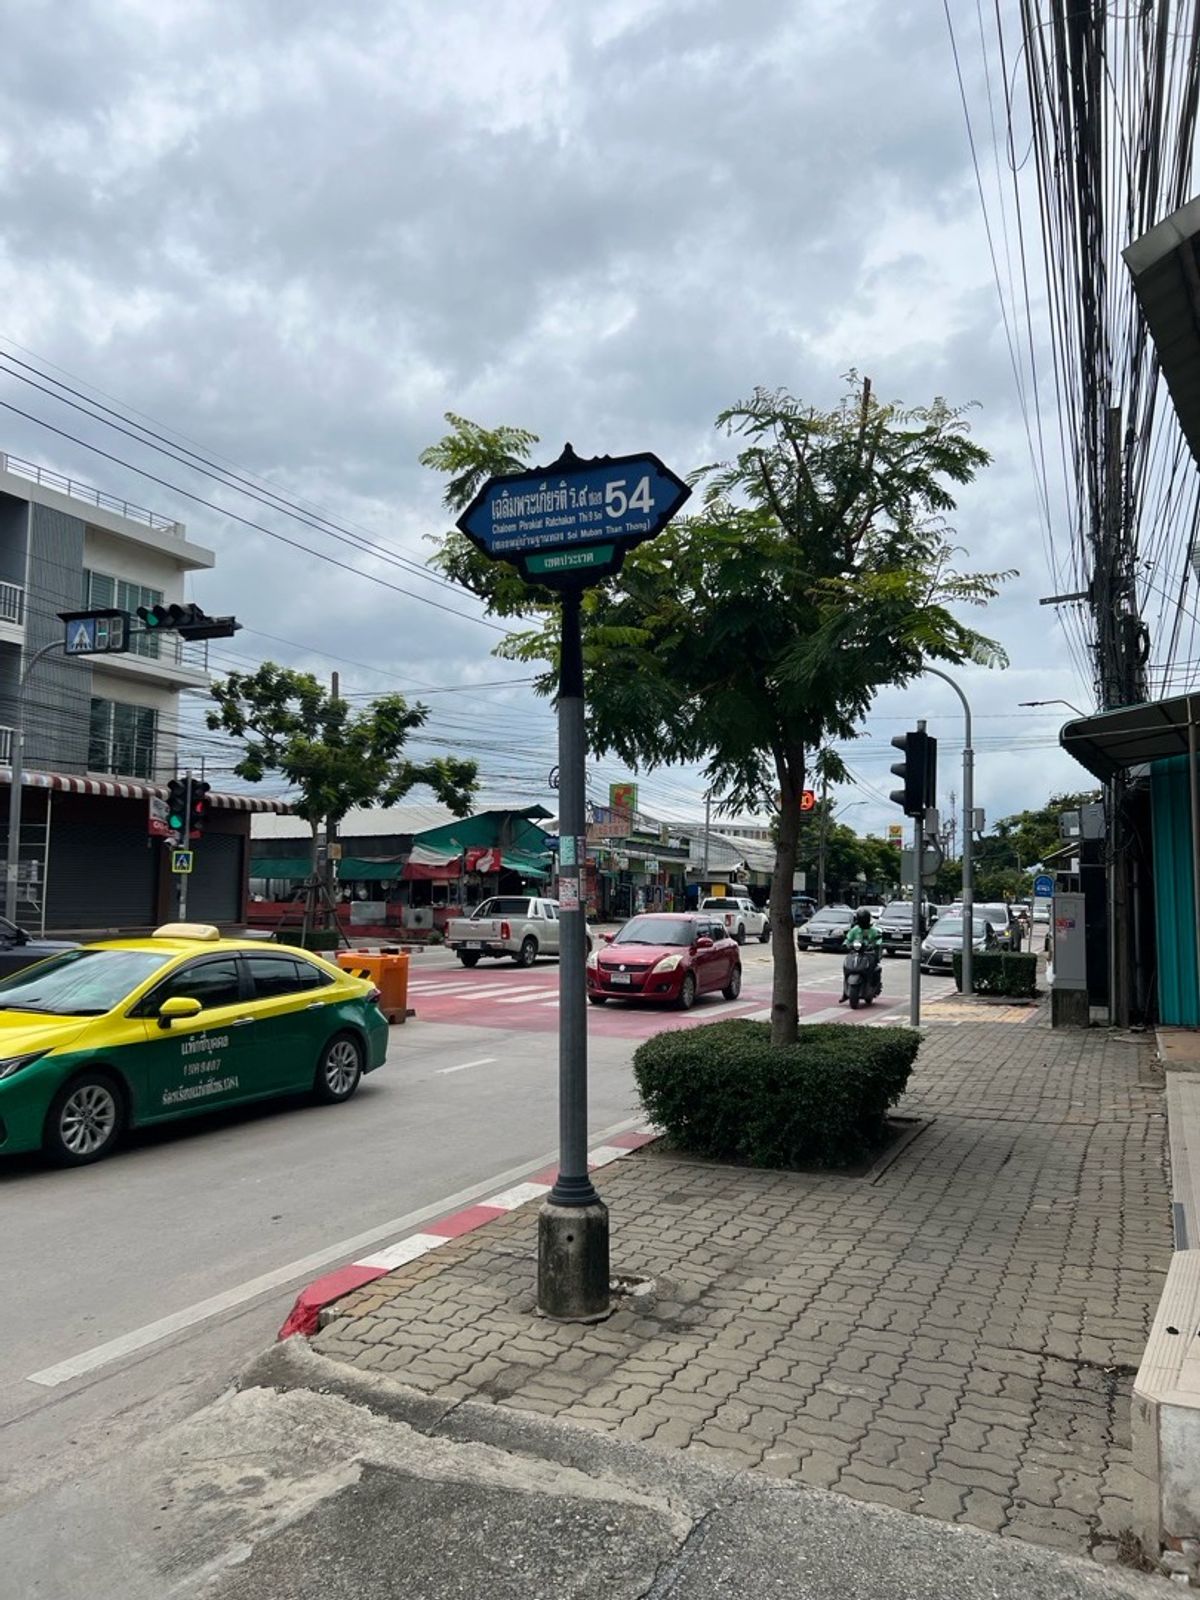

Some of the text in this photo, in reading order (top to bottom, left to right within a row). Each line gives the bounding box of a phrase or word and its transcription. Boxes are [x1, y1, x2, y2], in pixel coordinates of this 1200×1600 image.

[491, 480, 568, 520] เฉลิมพระเกียรติ
[605, 476, 655, 518] 54
[567, 530, 578, 541] Soi
[580, 529, 603, 539] Muban
